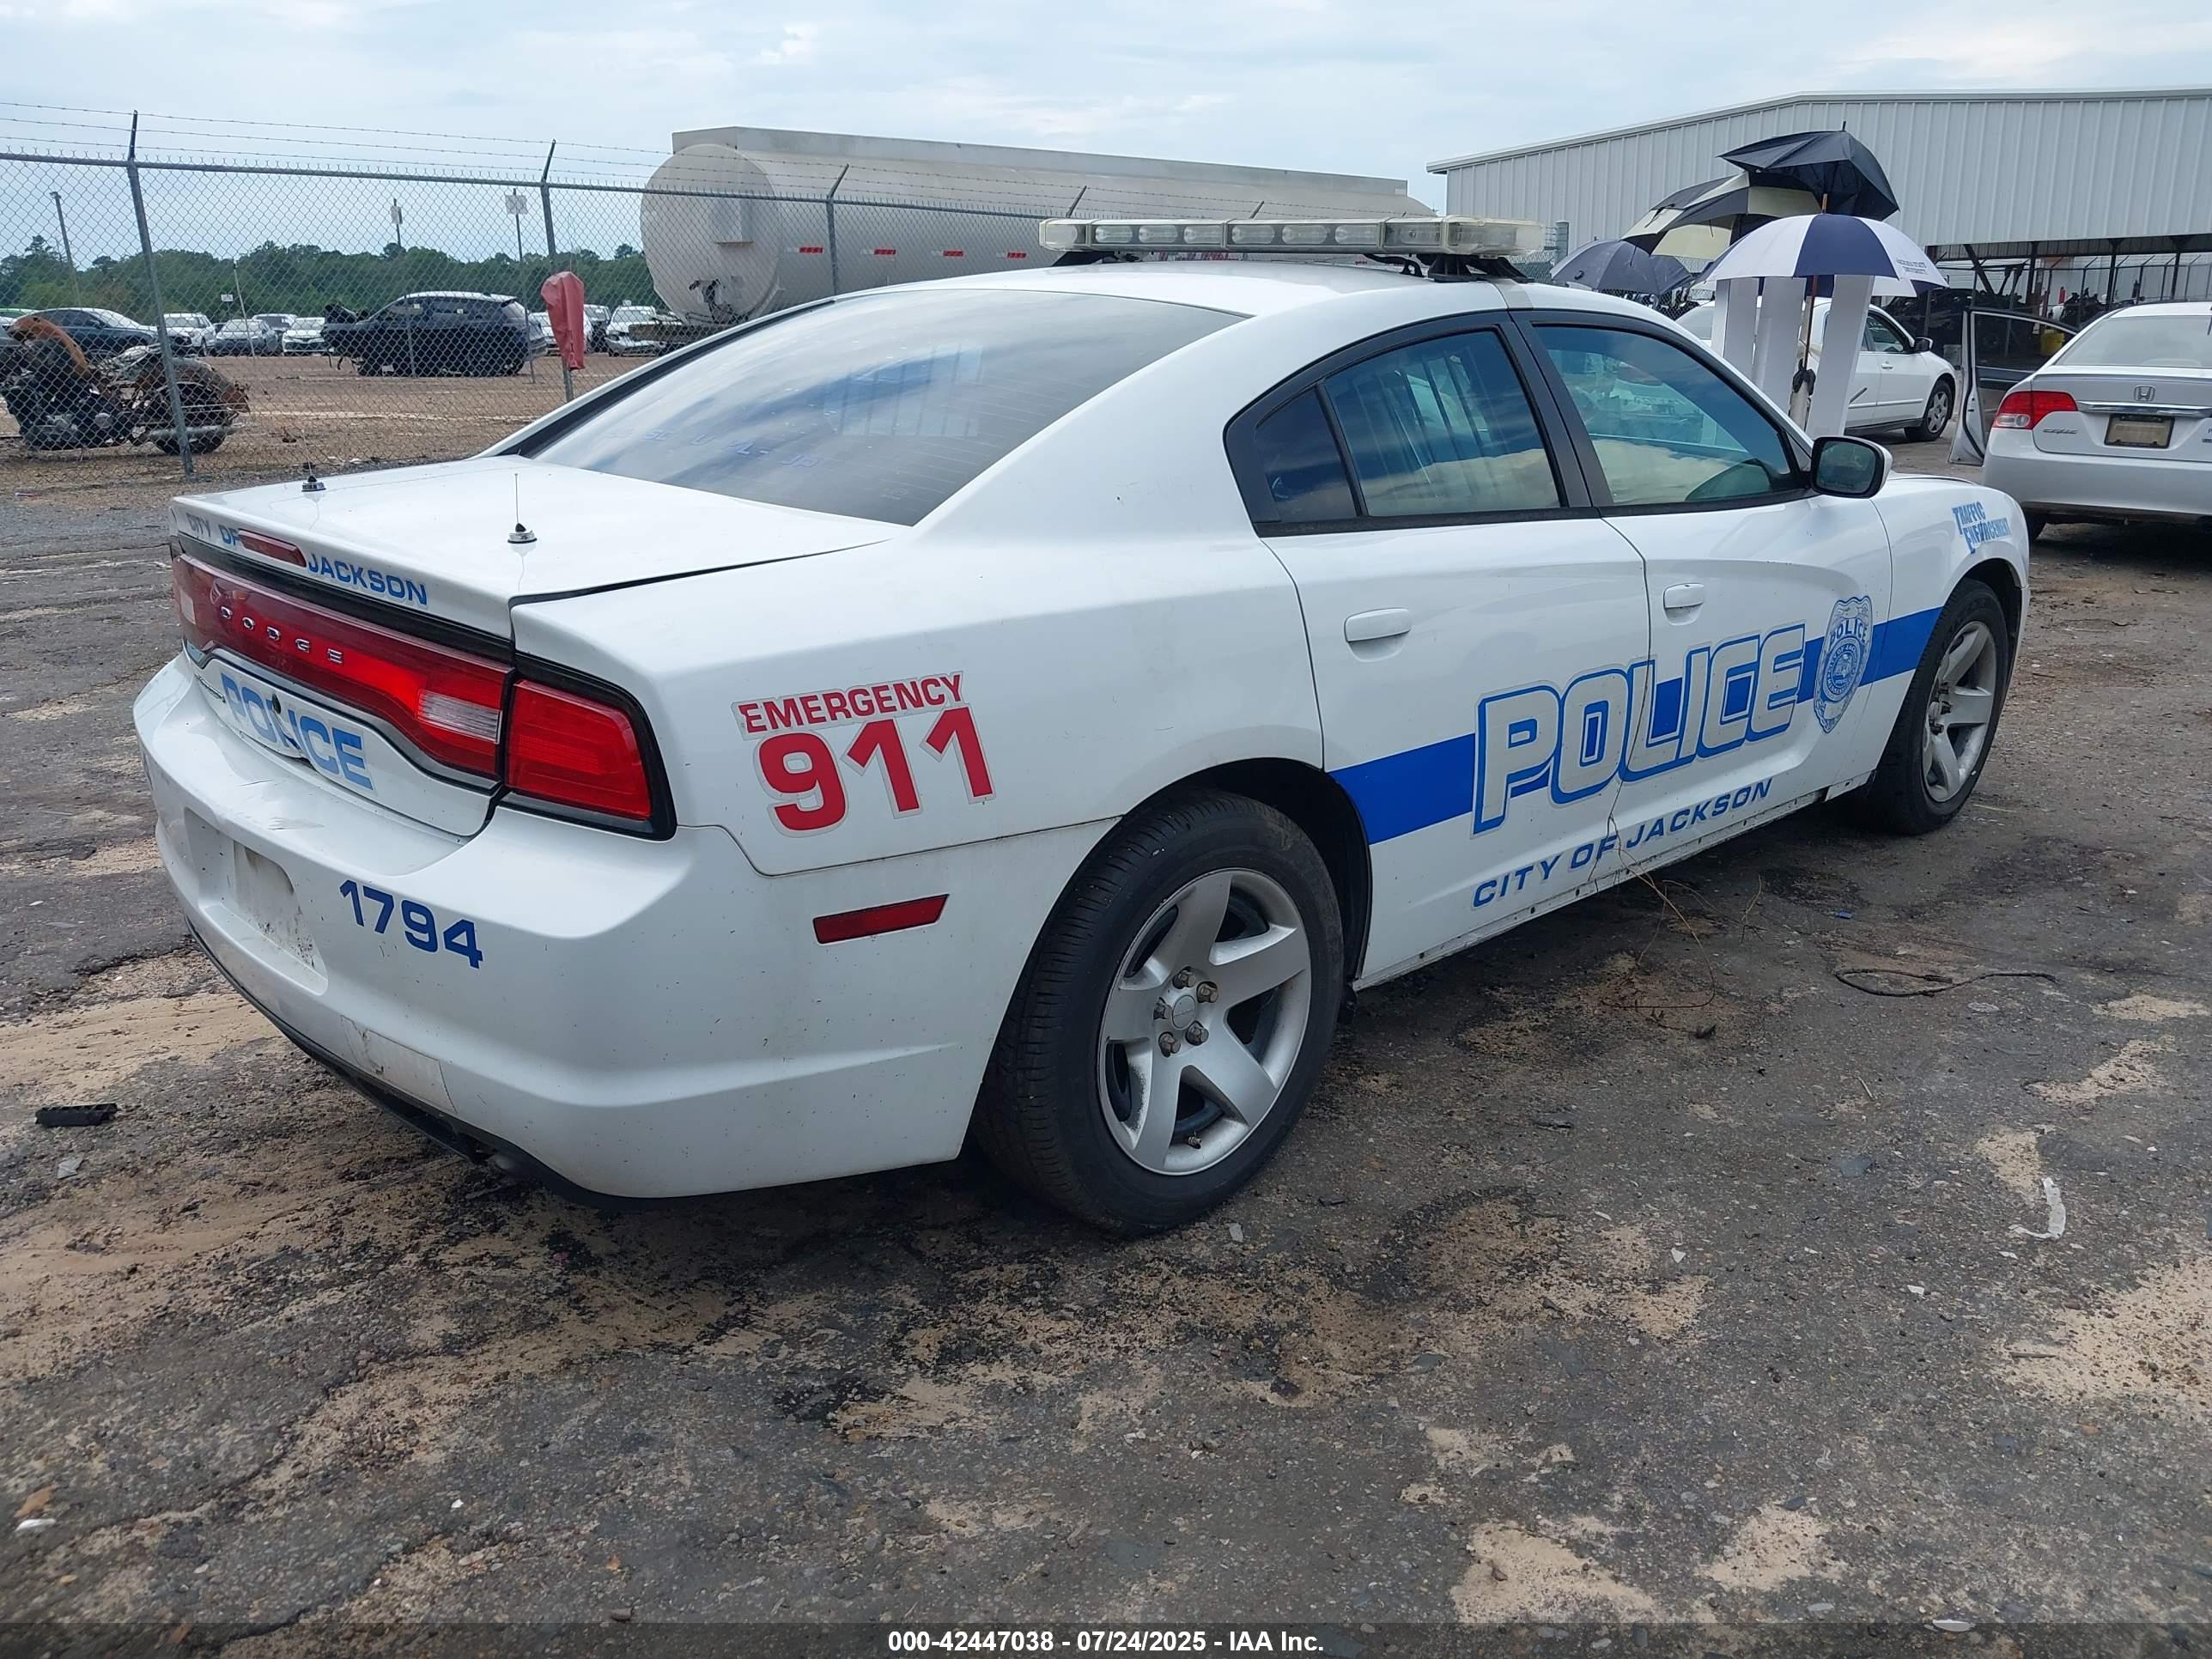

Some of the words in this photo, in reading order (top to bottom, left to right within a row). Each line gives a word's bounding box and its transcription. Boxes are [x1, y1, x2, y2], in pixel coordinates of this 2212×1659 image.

[1952, 501, 1986, 535] TRAFFIC
[218, 525, 240, 546] OF
[307, 553, 428, 605] JACKSON
[220, 605, 343, 665] DODGE
[1828, 619, 1868, 650] POLICE
[221, 672, 374, 791] POLICE
[738, 674, 961, 733] EMERGENCY
[1473, 623, 1805, 835] POLICE
[759, 706, 994, 831] 911
[1473, 855, 1561, 908] CITY
[1570, 834, 1618, 870] OF
[1626, 778, 1773, 848] JACKSON
[339, 879, 484, 969] 1794
